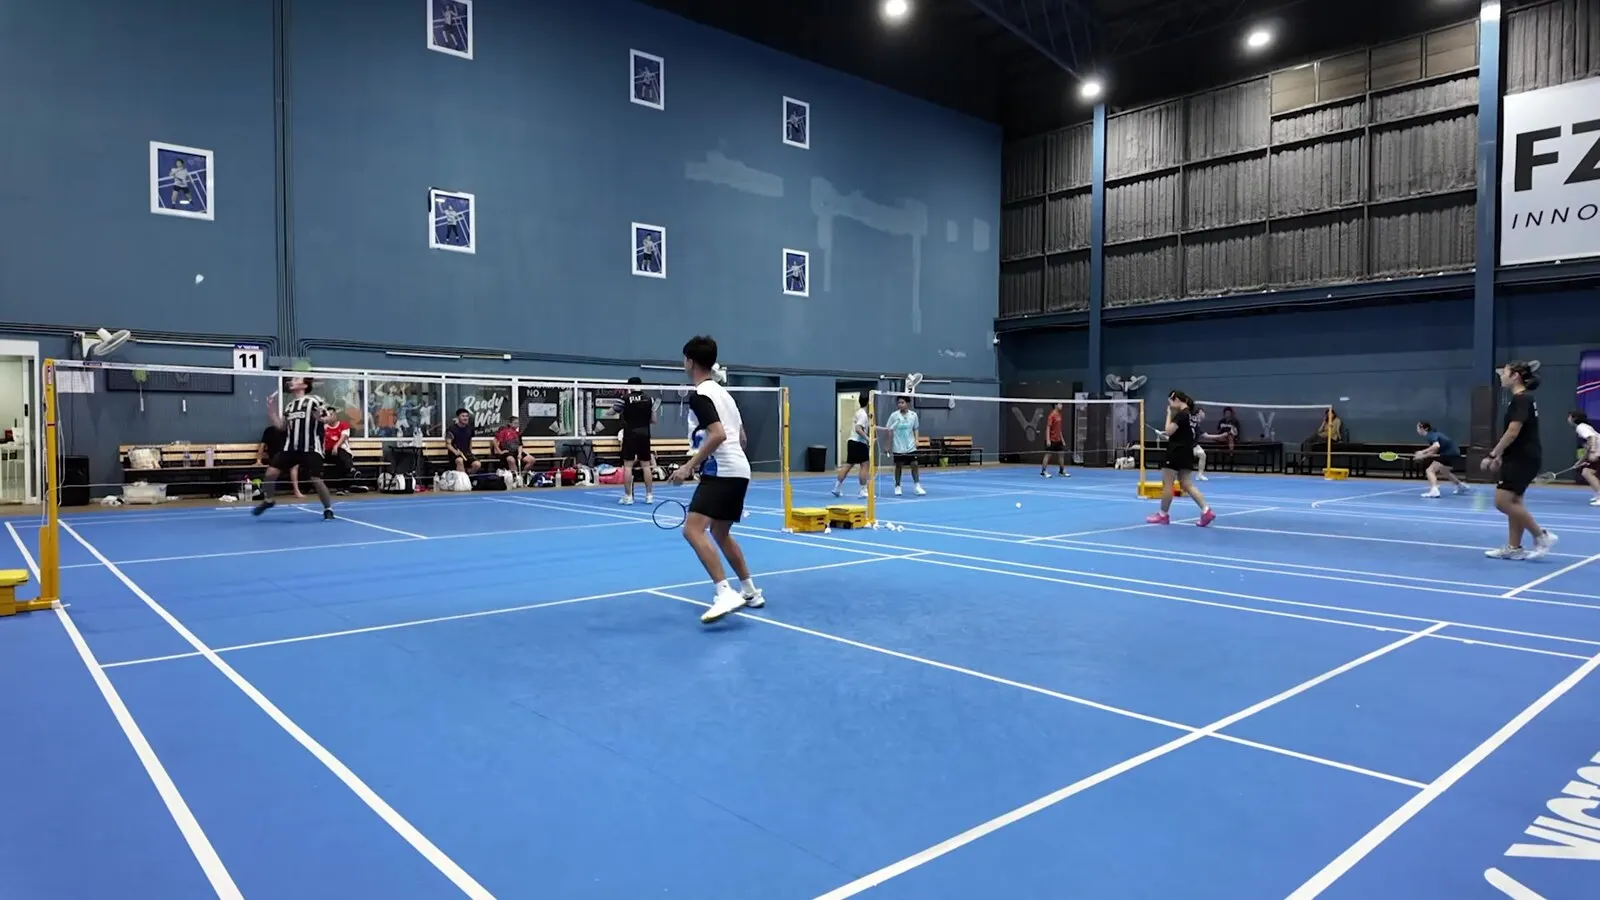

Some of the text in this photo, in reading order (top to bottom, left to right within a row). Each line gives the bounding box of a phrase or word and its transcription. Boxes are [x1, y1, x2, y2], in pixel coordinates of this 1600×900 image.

[239, 353, 257, 369] 11
[463, 392, 504, 415] Ready
[474, 409, 501, 428] Win
[1503, 748, 1600, 861] VIC
